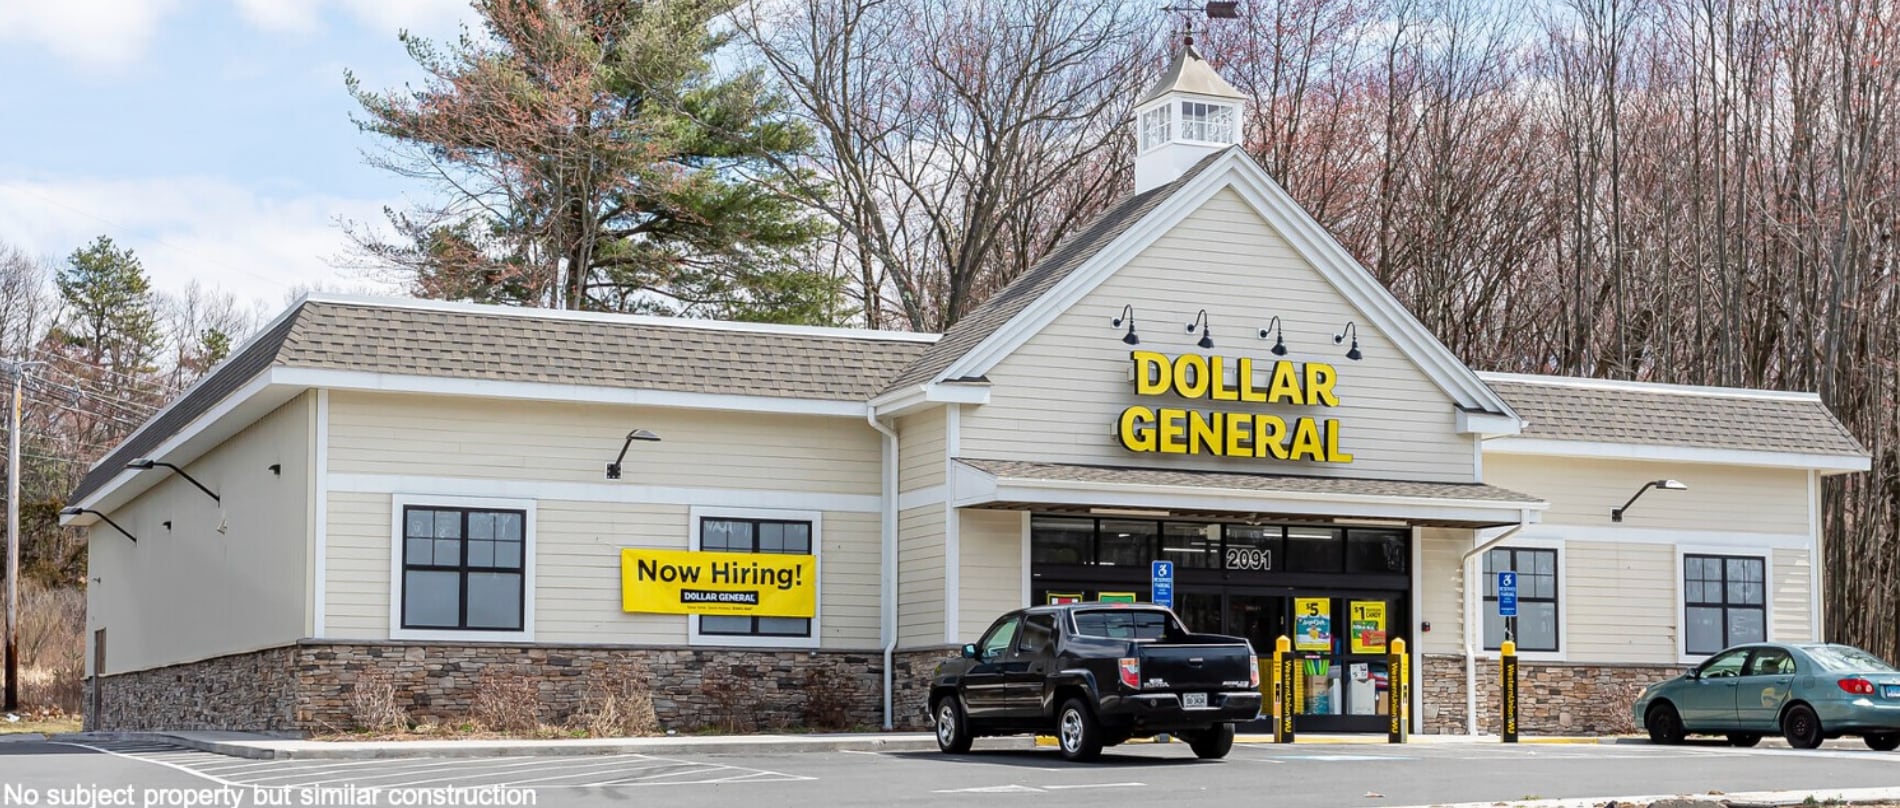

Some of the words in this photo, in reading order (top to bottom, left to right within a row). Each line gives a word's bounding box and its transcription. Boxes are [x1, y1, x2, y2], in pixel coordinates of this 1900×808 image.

[1131, 350, 1340, 408] DOLLAR
[1118, 405, 1354, 464] GENERAL
[1226, 549, 1272, 570] 2091
[637, 559, 701, 584] Now
[711, 561, 802, 590] Hiring!
[684, 592, 718, 601] DOLLAR
[718, 593, 756, 602] GENERAL
[1305, 602, 1319, 617] $5
[1354, 606, 1365, 620] $1
